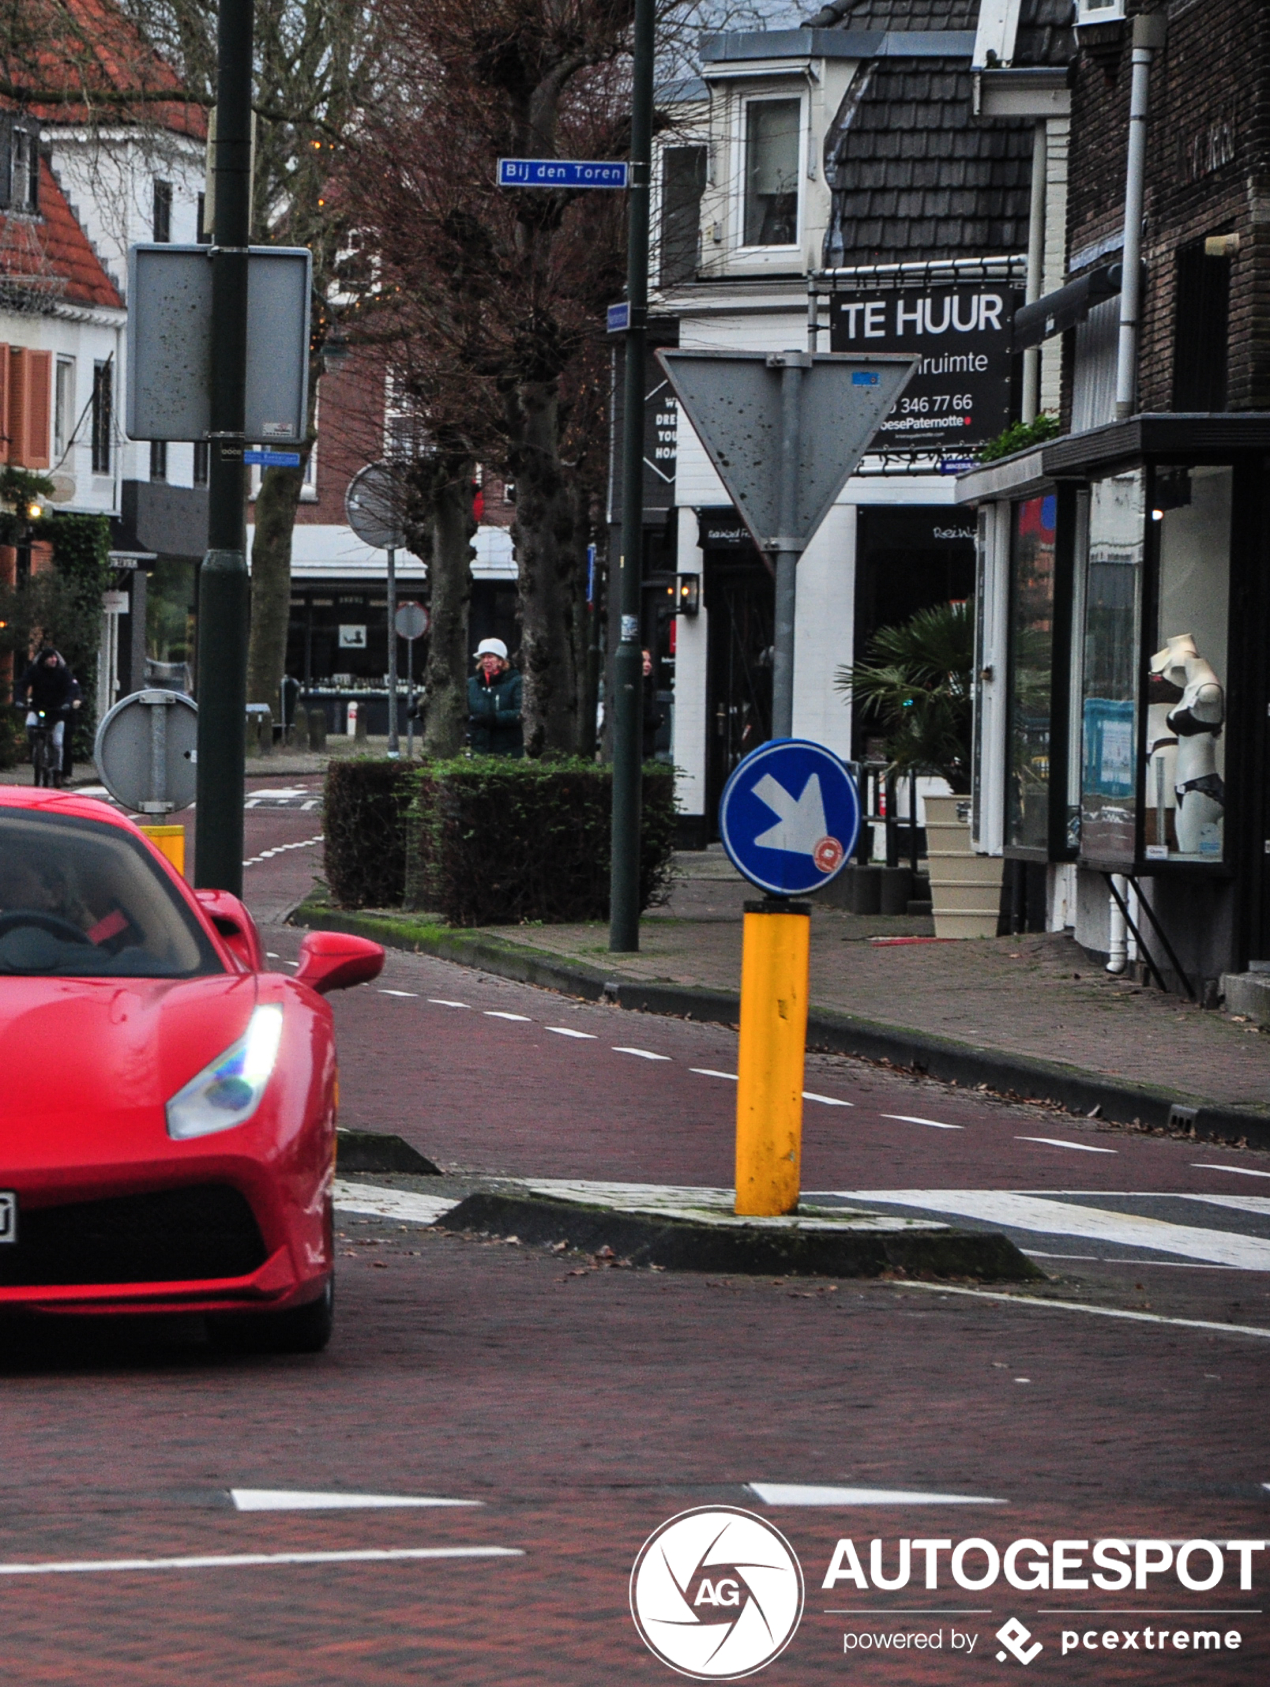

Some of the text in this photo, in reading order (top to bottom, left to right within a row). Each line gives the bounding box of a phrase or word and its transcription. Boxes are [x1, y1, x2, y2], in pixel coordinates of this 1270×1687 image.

[506, 164, 621, 181] Bij den Toren
[840, 293, 1003, 339] TE HUUR
[900, 397, 930, 414] 346
[932, 395, 951, 412] 77
[952, 393, 973, 410] 66
[655, 414, 677, 425] DRE
[880, 415, 964, 431] oesePaternotte
[658, 431, 677, 442] YOU
[655, 448, 677, 459] HOM
